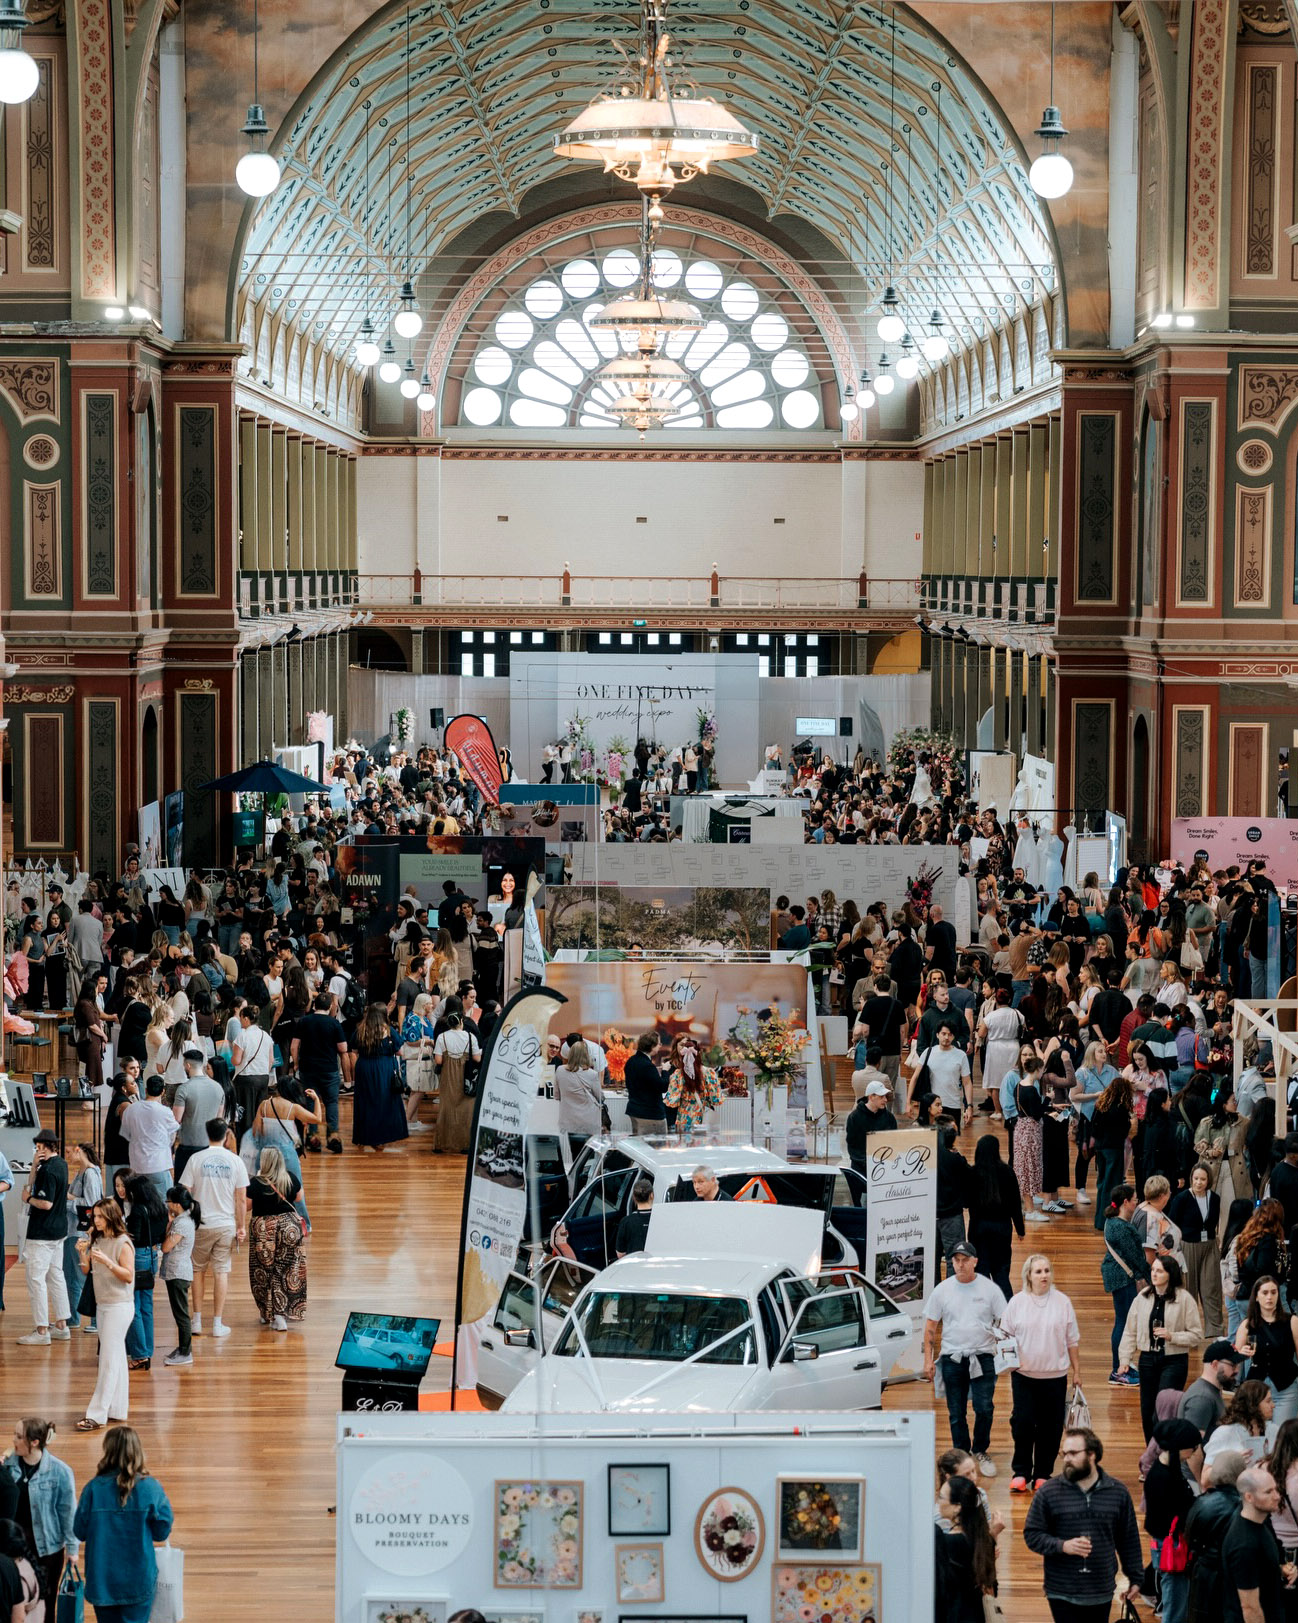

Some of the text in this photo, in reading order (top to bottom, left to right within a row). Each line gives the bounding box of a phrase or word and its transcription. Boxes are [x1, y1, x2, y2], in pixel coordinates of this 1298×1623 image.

[577, 684, 610, 699] ONE
[596, 704, 674, 724] wedding expo
[346, 874, 381, 886] ADAWN
[641, 968, 708, 1005] Events
[655, 1000, 682, 1011] by TCC
[498, 1024, 518, 1056] E
[871, 1146, 894, 1182] E
[902, 1145, 931, 1176] R
[881, 1218, 894, 1230] Your
[894, 1215, 909, 1227] special
[877, 1228, 923, 1245] for your perfect day
[355, 1513, 470, 1524] BLOOMY DAYS
